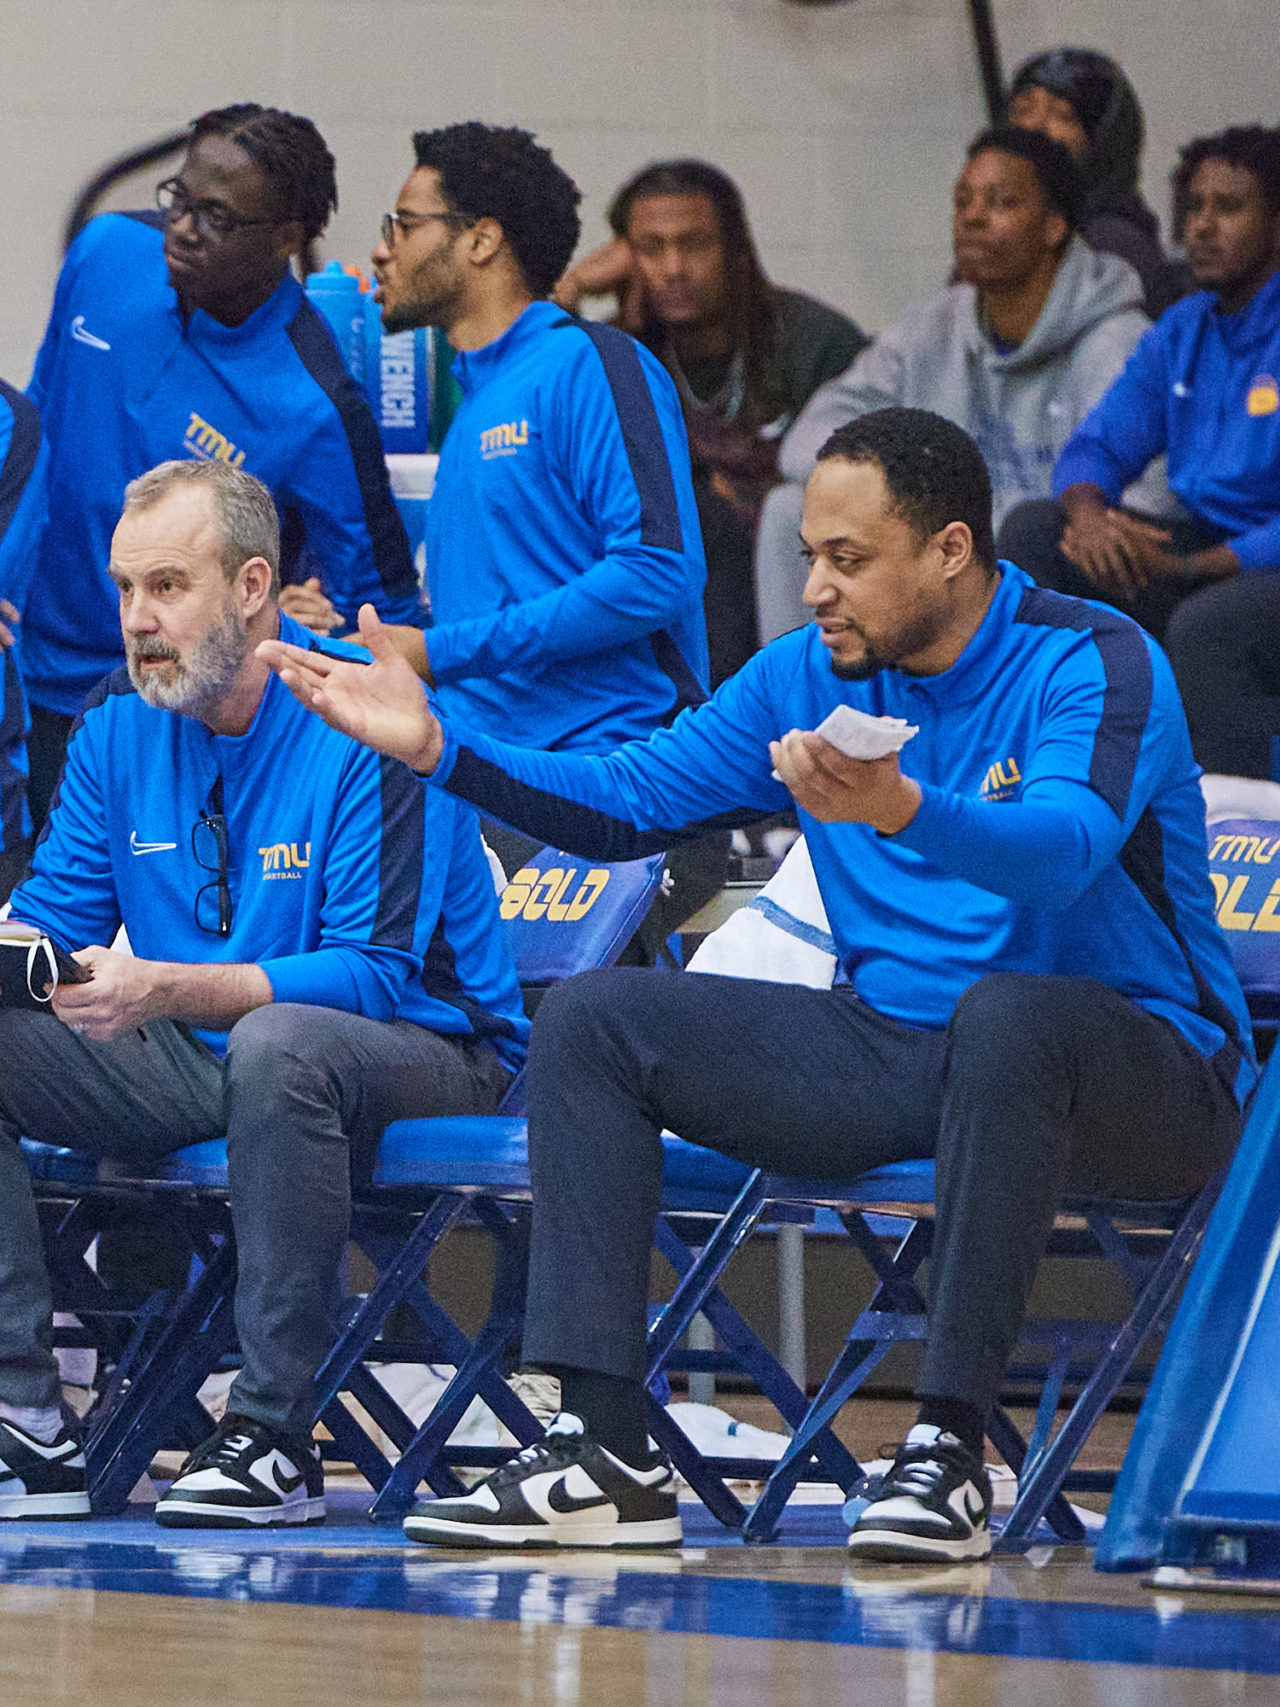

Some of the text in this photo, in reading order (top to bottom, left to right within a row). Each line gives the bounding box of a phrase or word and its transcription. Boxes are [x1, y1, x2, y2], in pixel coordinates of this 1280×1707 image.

[186, 412, 246, 467] TMU
[259, 842, 311, 871] TMU
[1208, 834, 1280, 864] TMU
